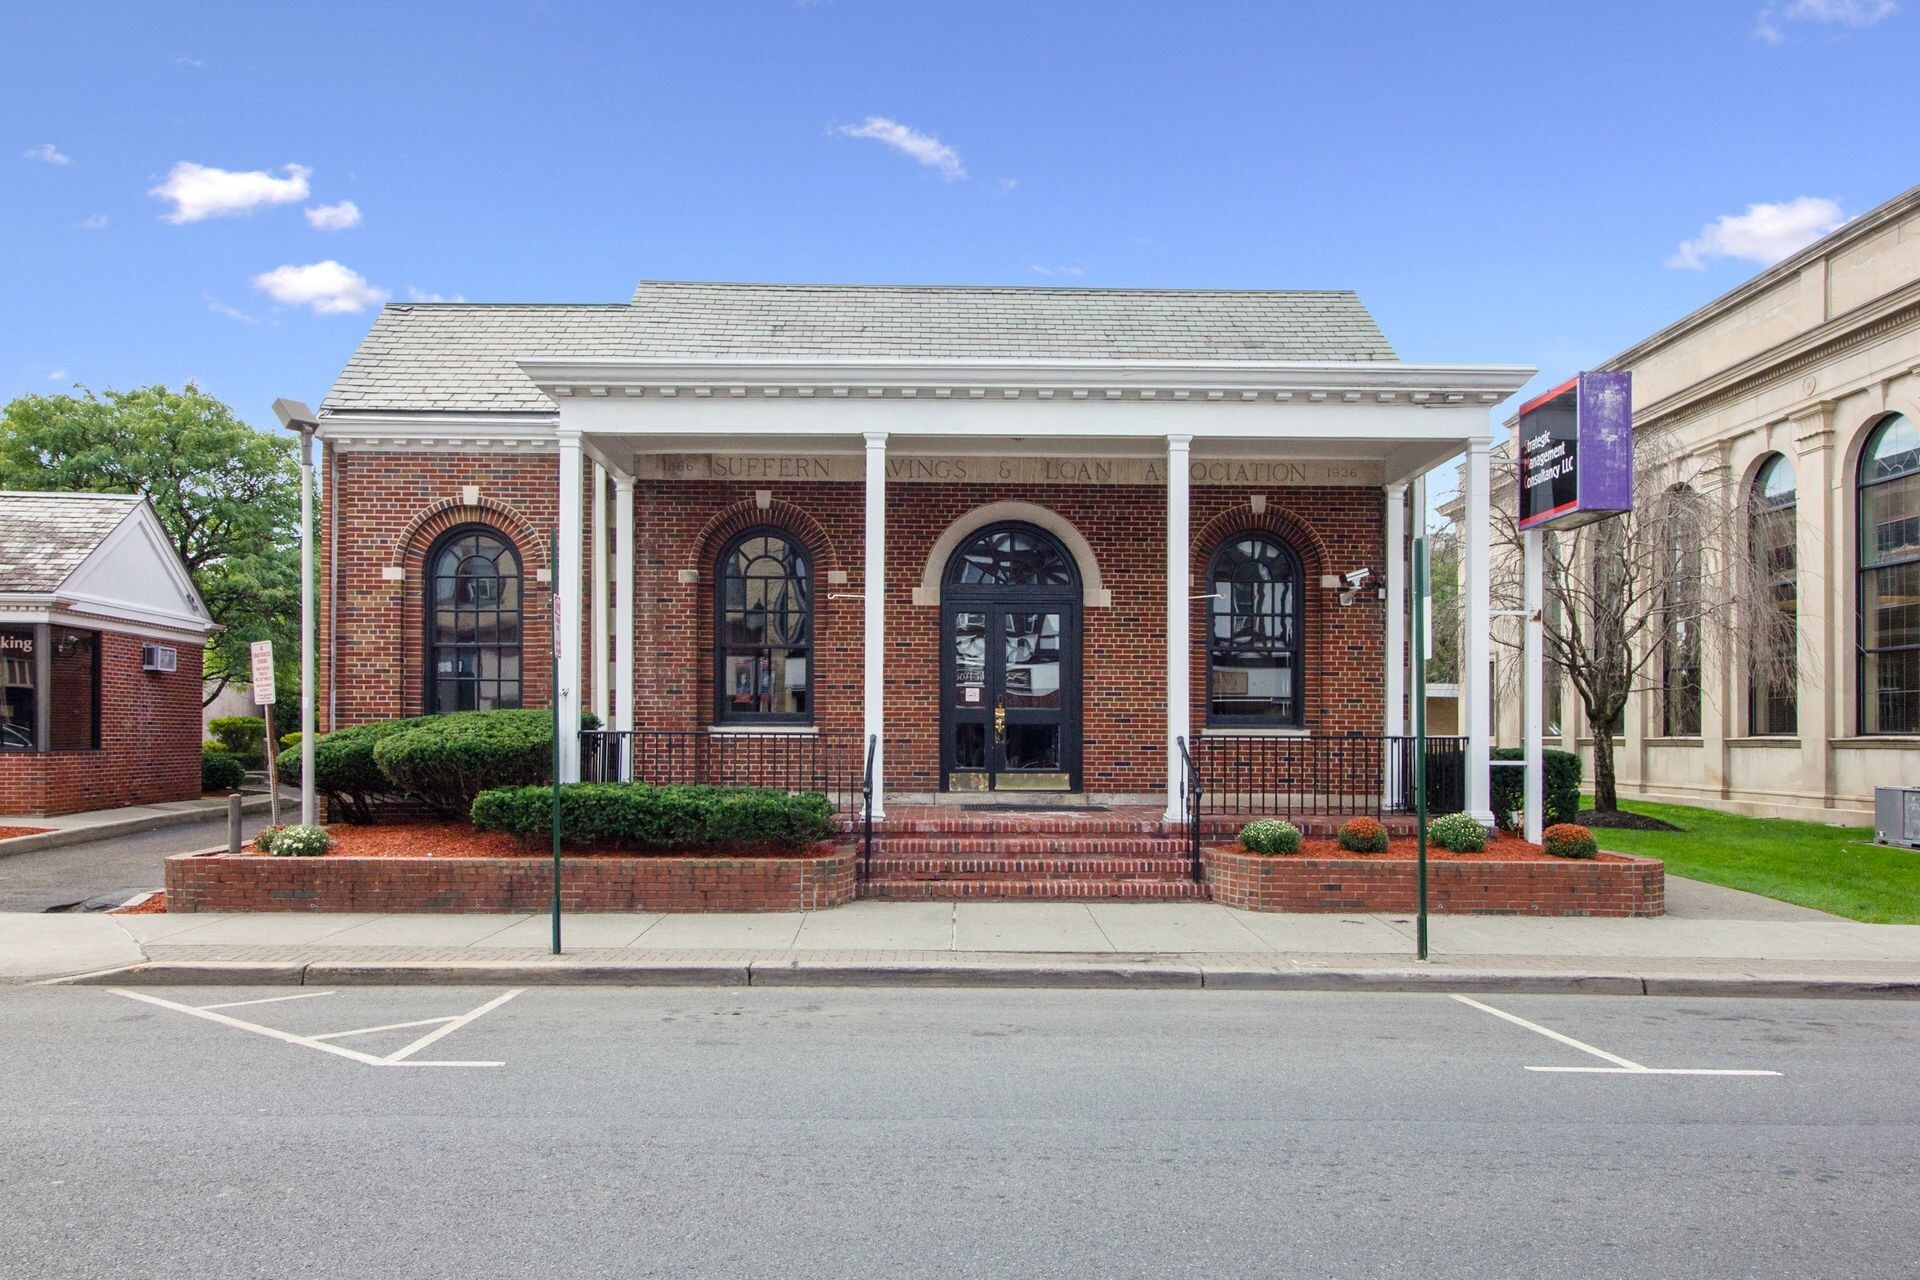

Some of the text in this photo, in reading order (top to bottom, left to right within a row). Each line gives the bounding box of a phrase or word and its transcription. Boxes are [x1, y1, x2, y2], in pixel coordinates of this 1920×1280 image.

[713, 457, 1306, 482] SUFFERN VINGS & LOAN AOCIATION
[1524, 441, 1565, 471] Management
[1327, 467, 1358, 478] 1936
[1524, 456, 1574, 489] Consultancy LLC
